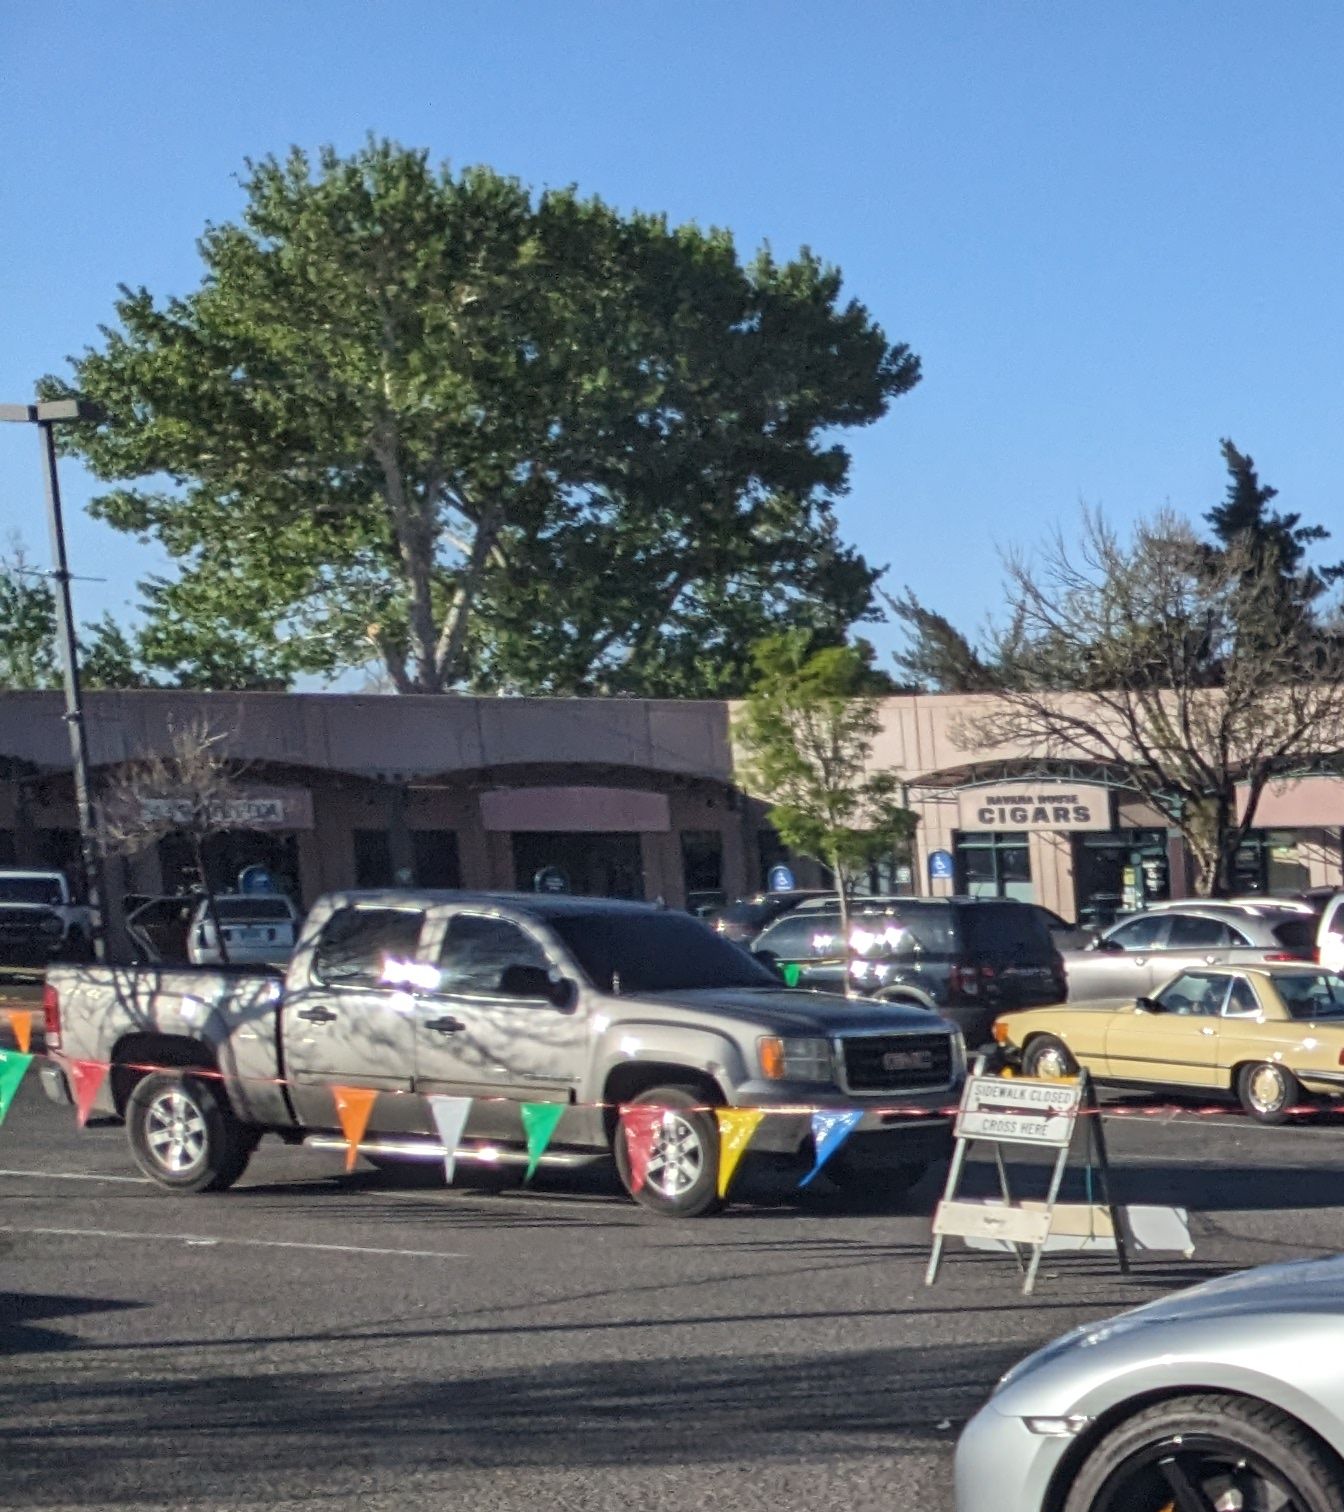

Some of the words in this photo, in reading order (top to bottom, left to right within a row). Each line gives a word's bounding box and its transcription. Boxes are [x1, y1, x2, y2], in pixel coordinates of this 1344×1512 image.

[978, 805, 1091, 824] CIGARS
[974, 1084, 1026, 1101] SIDEWALK
[1029, 1089, 1072, 1104] CLOSED
[981, 1118, 1018, 1133] CROSS
[1020, 1122, 1049, 1136] HERE
